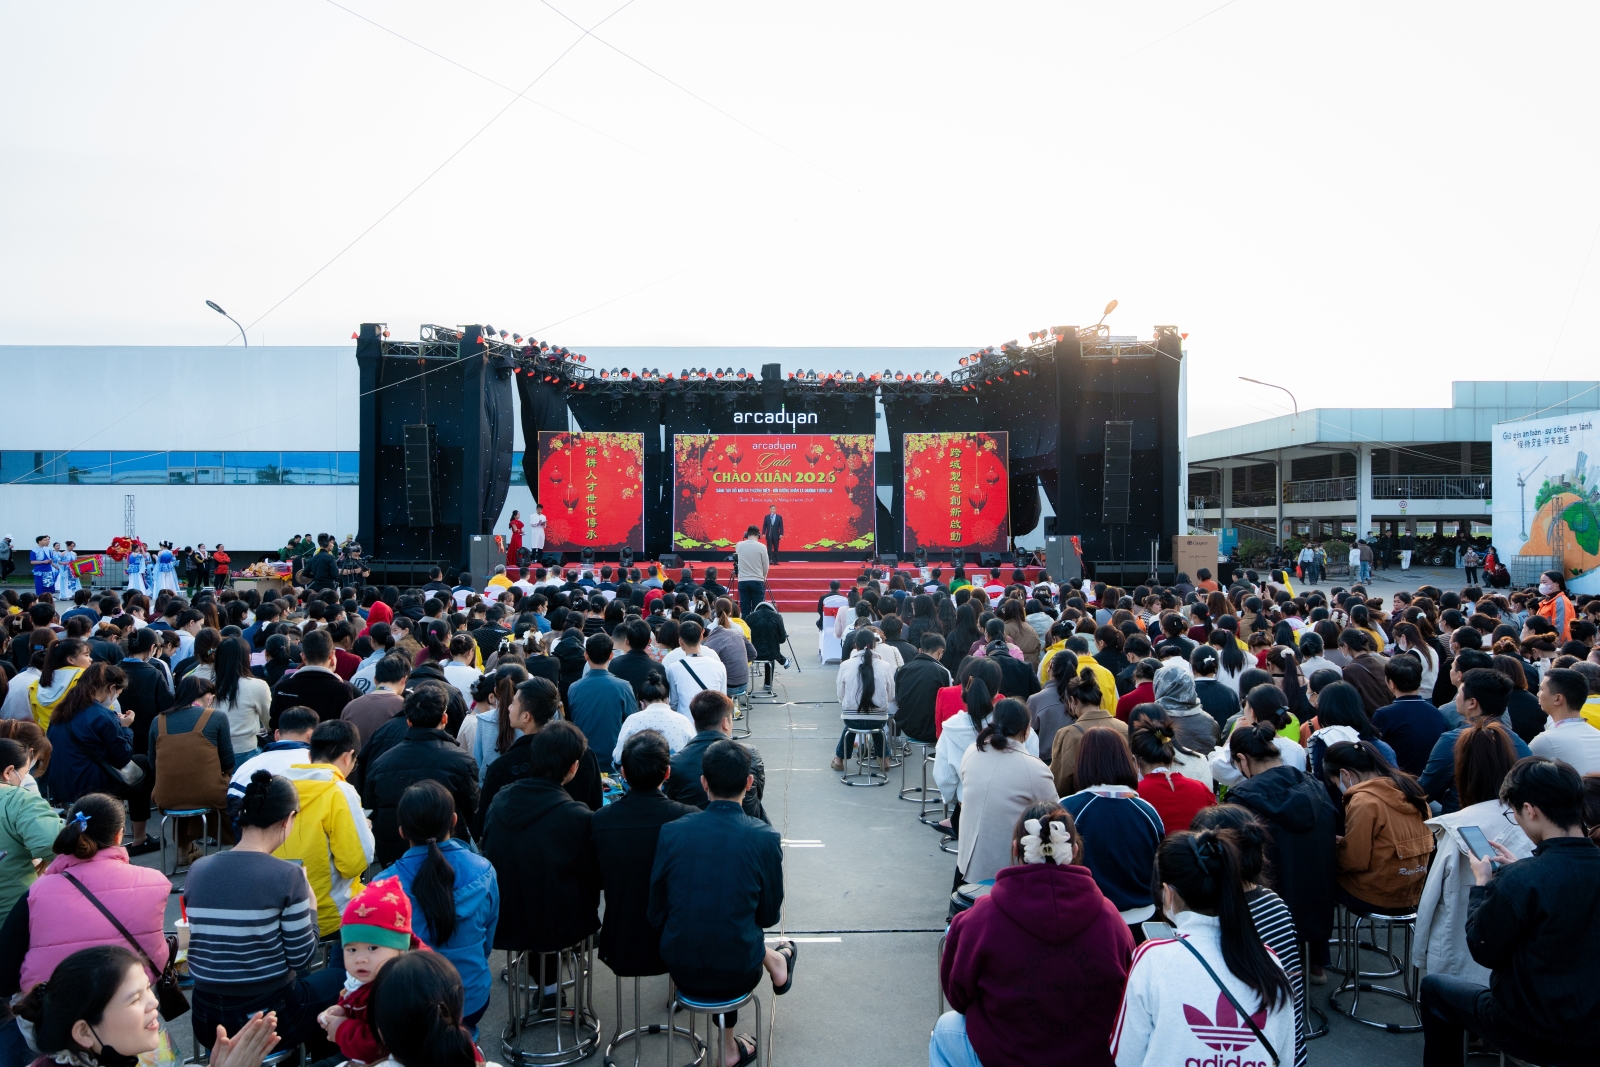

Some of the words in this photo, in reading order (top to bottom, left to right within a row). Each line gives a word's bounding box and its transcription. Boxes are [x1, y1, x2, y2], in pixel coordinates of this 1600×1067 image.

[733, 404, 818, 433] arcadyan
[752, 438, 797, 455] arcadyan
[757, 452, 792, 471] Gala
[713, 470, 752, 483] CHÀO
[754, 470, 792, 483] XUÂN
[795, 470, 837, 483] 2026
